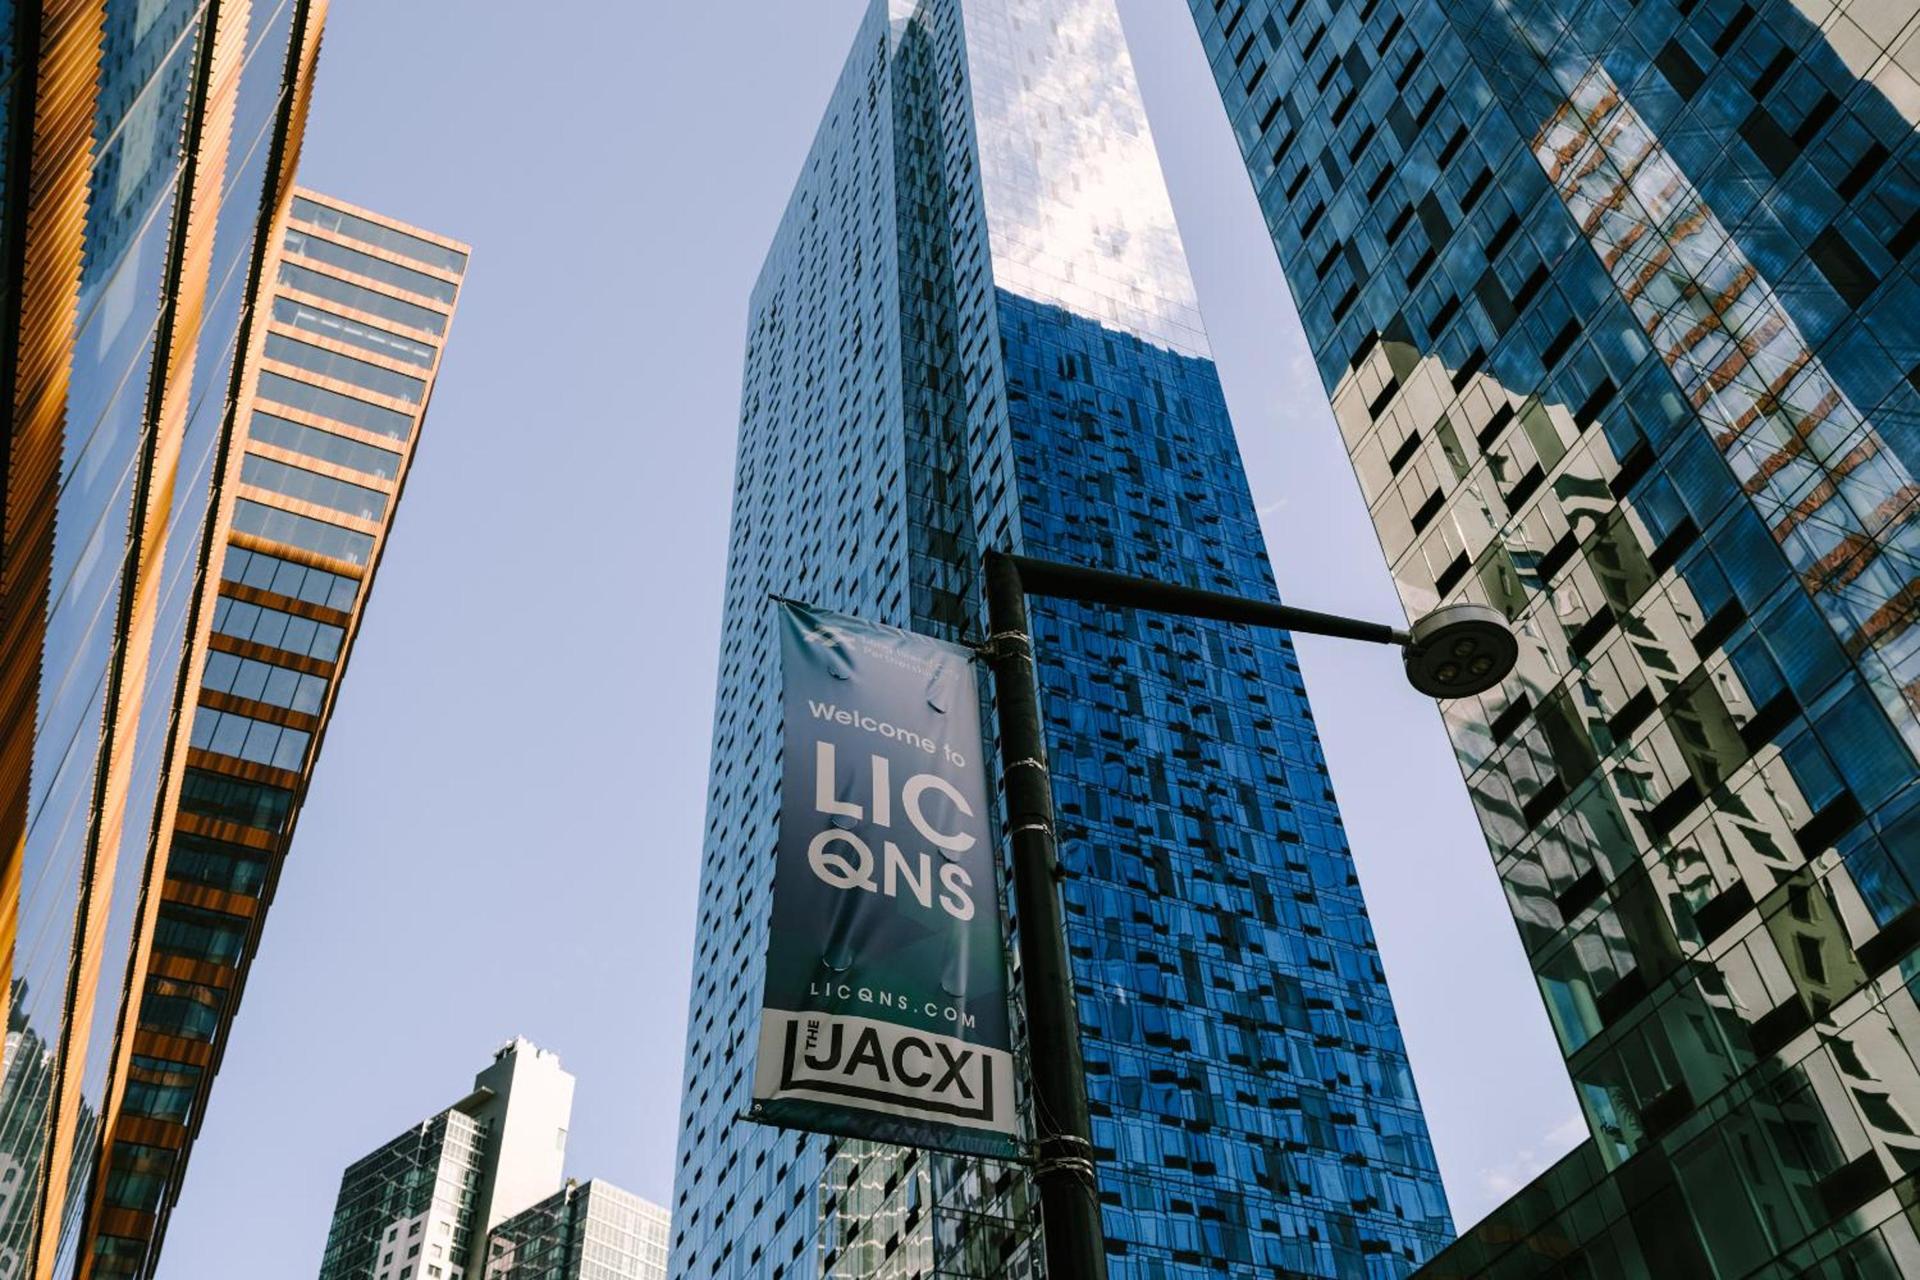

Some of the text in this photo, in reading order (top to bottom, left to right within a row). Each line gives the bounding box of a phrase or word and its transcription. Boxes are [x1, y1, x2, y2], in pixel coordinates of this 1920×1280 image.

[808, 699, 966, 768] Welcome to
[815, 740, 977, 852] LIC
[807, 828, 975, 921] QNS
[805, 1019, 820, 1051] THE
[810, 982, 976, 1029] LICQNS.COM
[804, 1023, 975, 1099] JACX
